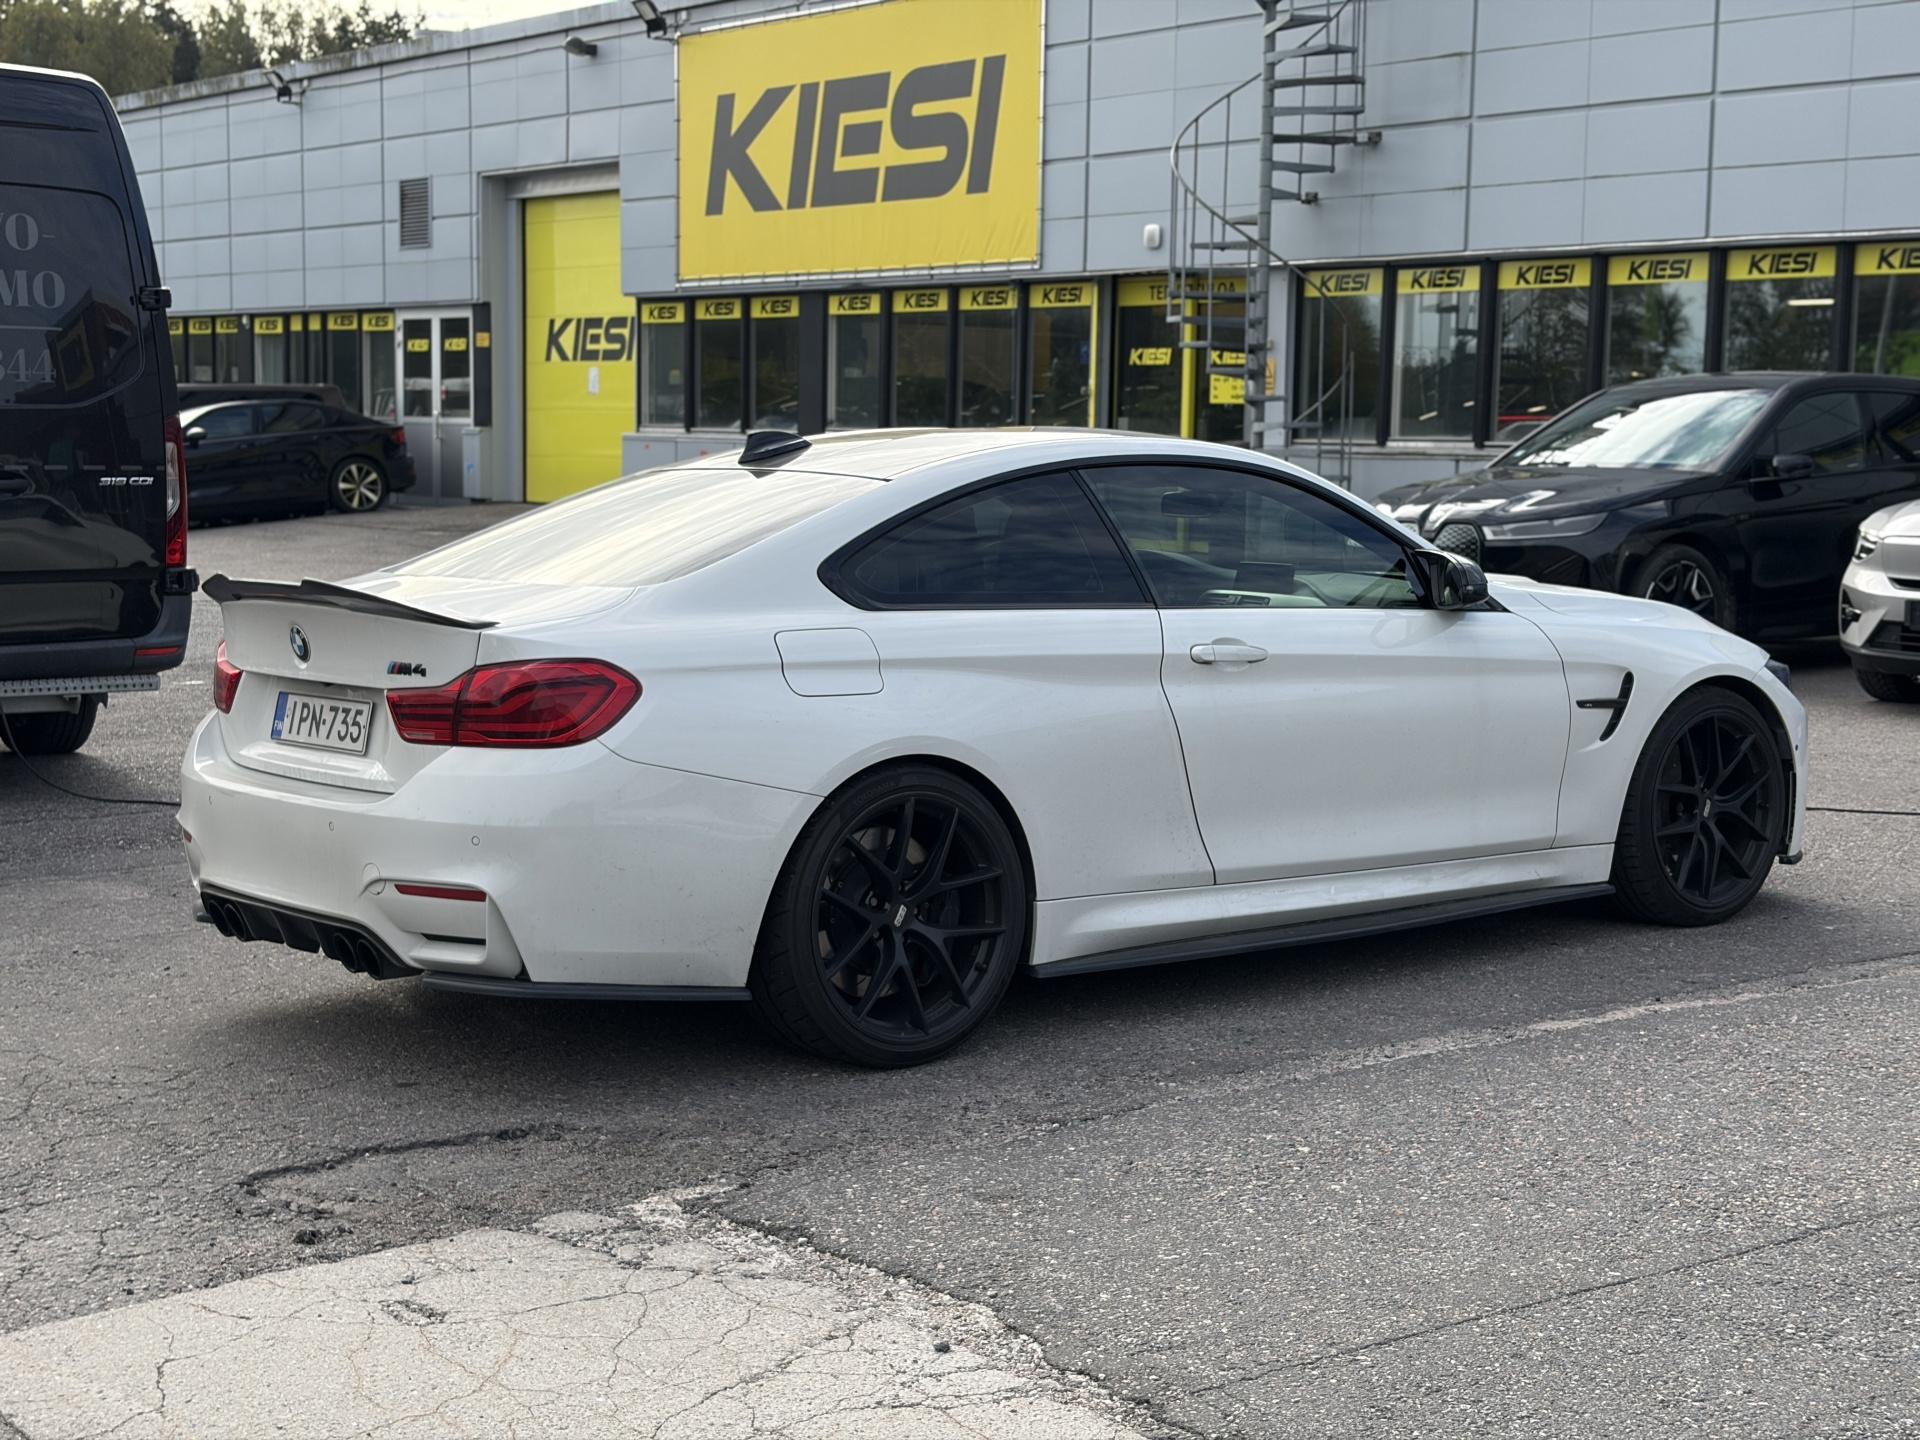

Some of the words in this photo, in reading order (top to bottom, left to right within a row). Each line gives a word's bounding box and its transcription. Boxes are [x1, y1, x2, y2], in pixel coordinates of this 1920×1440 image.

[705, 54, 1006, 216] KIESI
[1627, 258, 1692, 281] KIESI
[1748, 252, 1817, 275] KIESI
[1319, 272, 1370, 293] KIESI
[1410, 269, 1465, 290] KIESI
[1515, 264, 1575, 286] KIESI
[837, 295, 871, 311] KIESI
[903, 292, 940, 308] KIESI
[970, 290, 1009, 307] KIESI
[1042, 287, 1083, 305] KIESI
[649, 306, 677, 320] KIESI
[704, 301, 735, 316] KIESI
[760, 299, 792, 315] KIESI
[545, 316, 635, 361] KIESI
[1129, 348, 1172, 365] KIESI
[129, 476, 154, 486] CDI
[398, 662, 427, 677] M4
[288, 700, 364, 744] IPN-735
